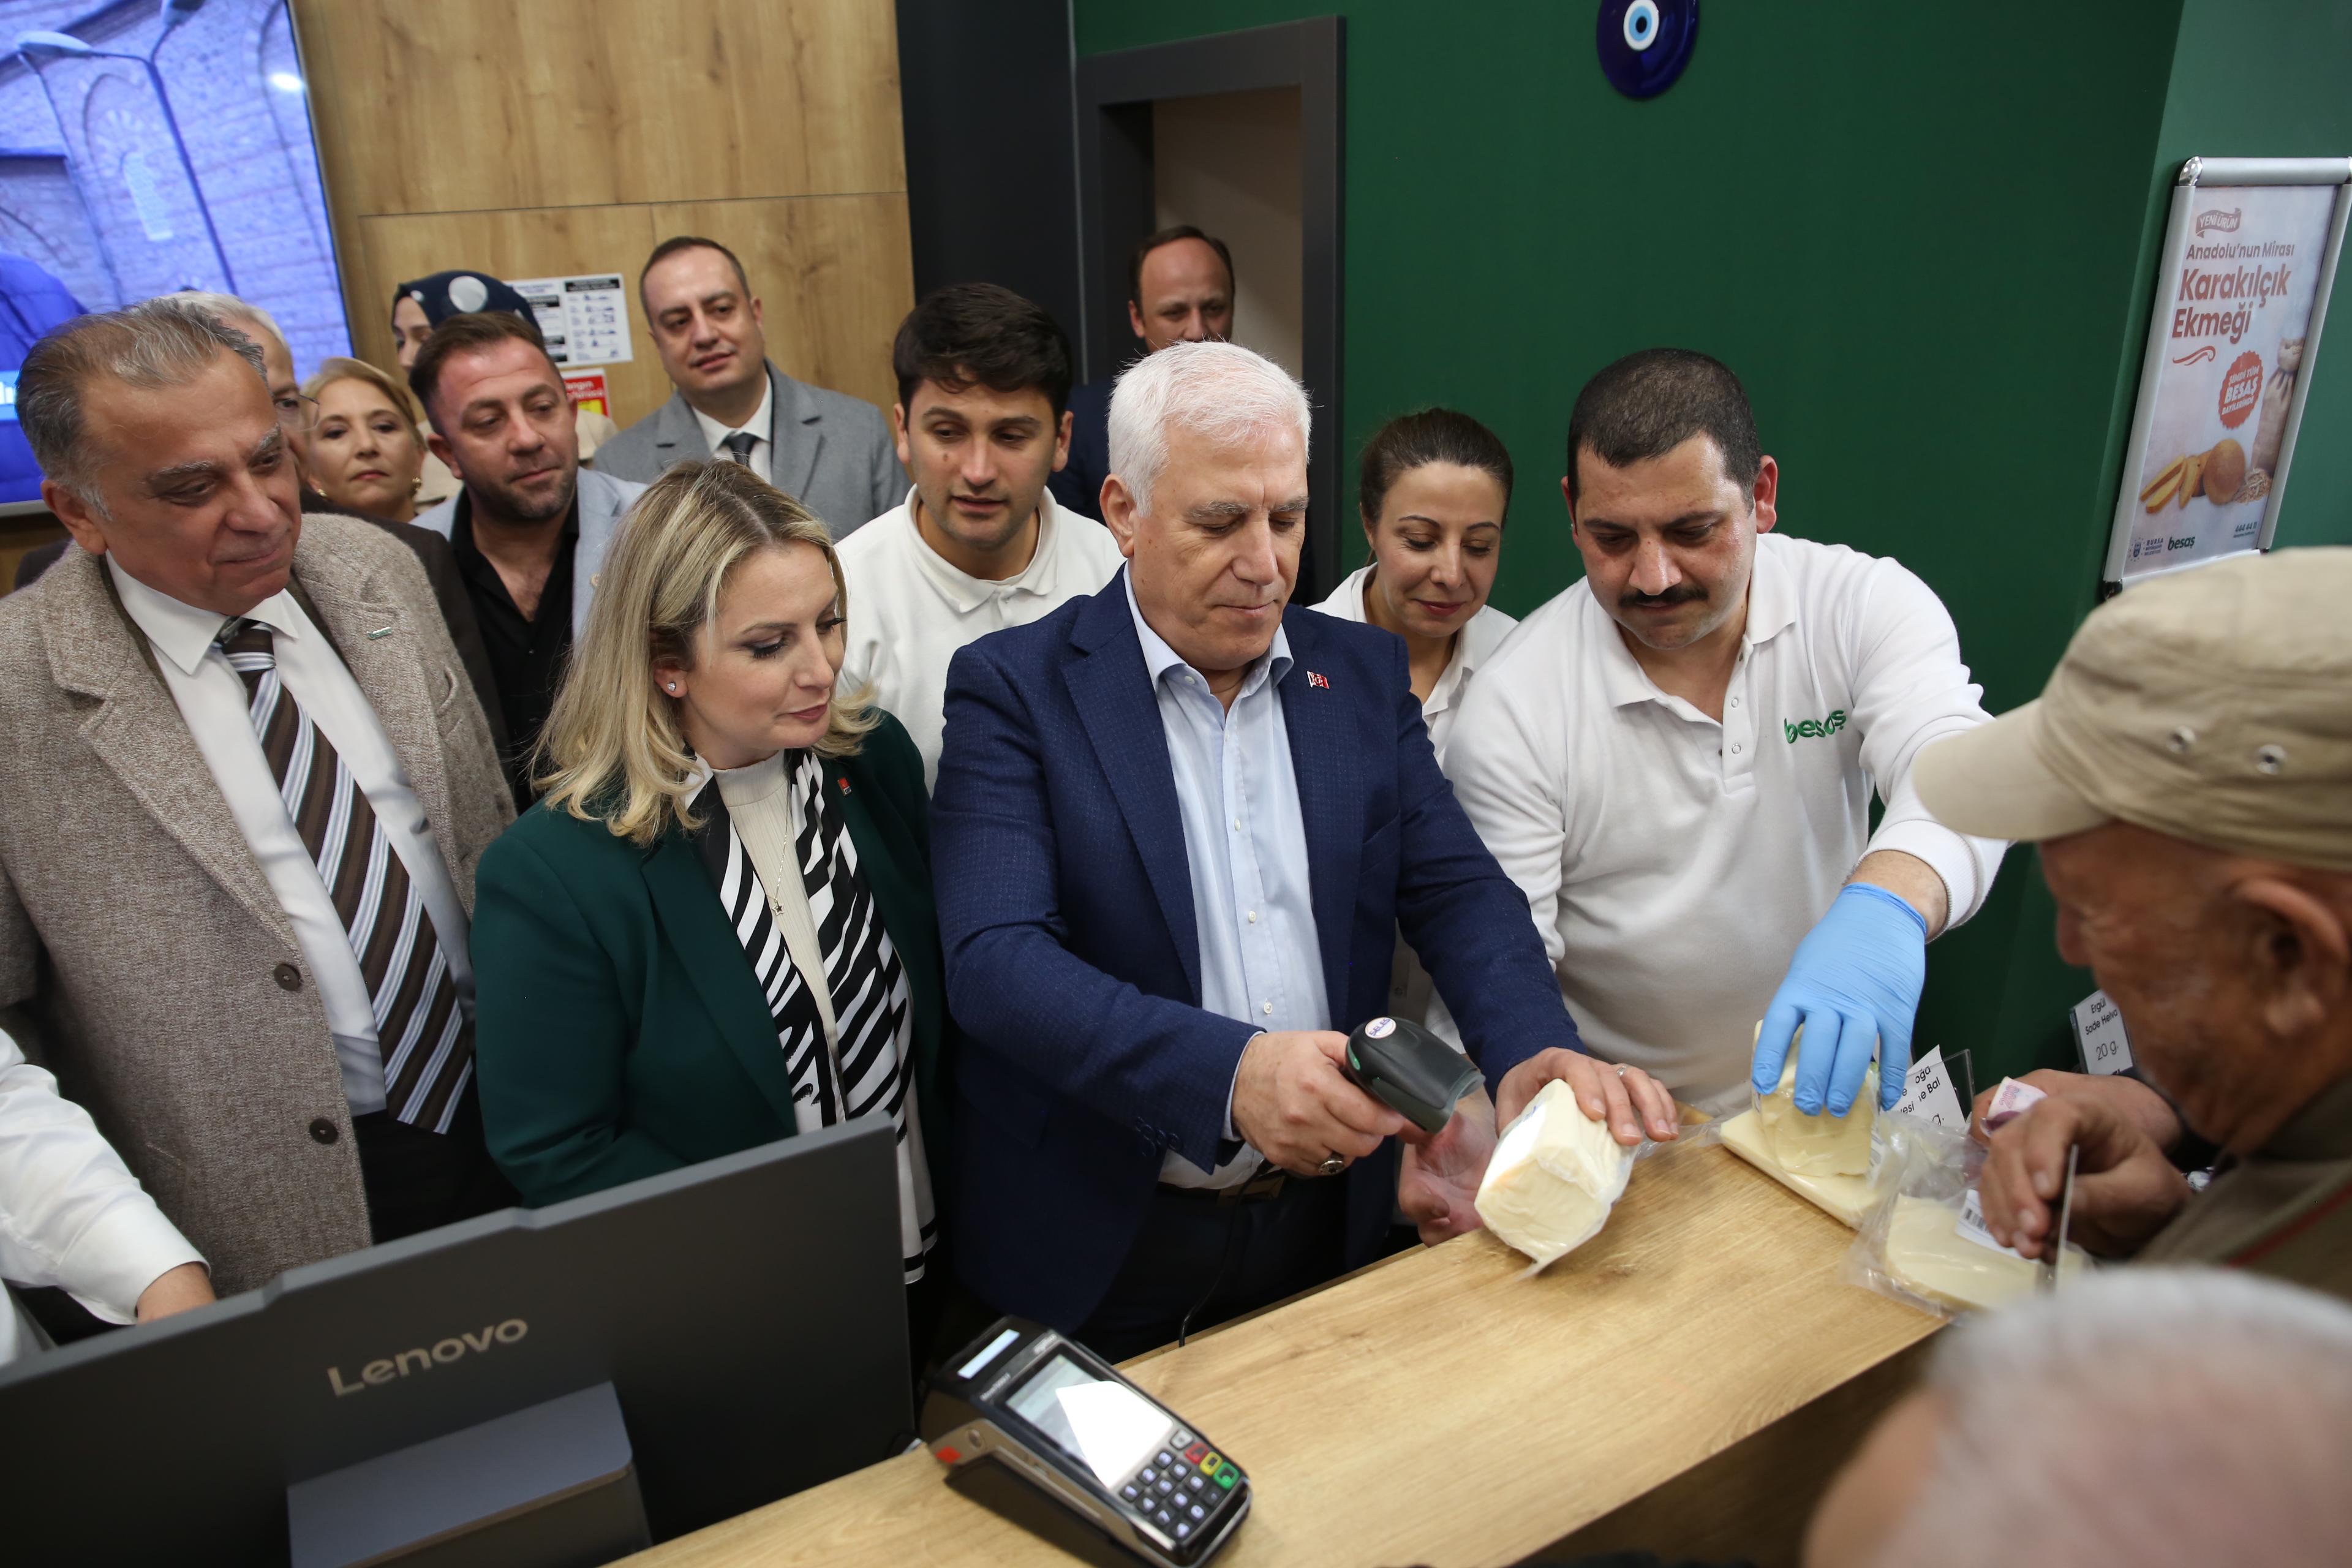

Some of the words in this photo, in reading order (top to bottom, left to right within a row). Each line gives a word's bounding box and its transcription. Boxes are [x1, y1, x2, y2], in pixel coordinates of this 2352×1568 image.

[2179, 263, 2291, 308] Karakılçık
[2172, 301, 2253, 344] Ekmeği
[2168, 536, 2195, 551] besaş
[2090, 998, 2107, 1014] Ergül
[2085, 1020, 2101, 1035] Sade
[2095, 1042, 2109, 1061] 20
[1915, 1066, 1931, 1084] oğa
[1926, 1076, 1940, 1094] Bal
[327, 1319, 528, 1396] Lenovo
